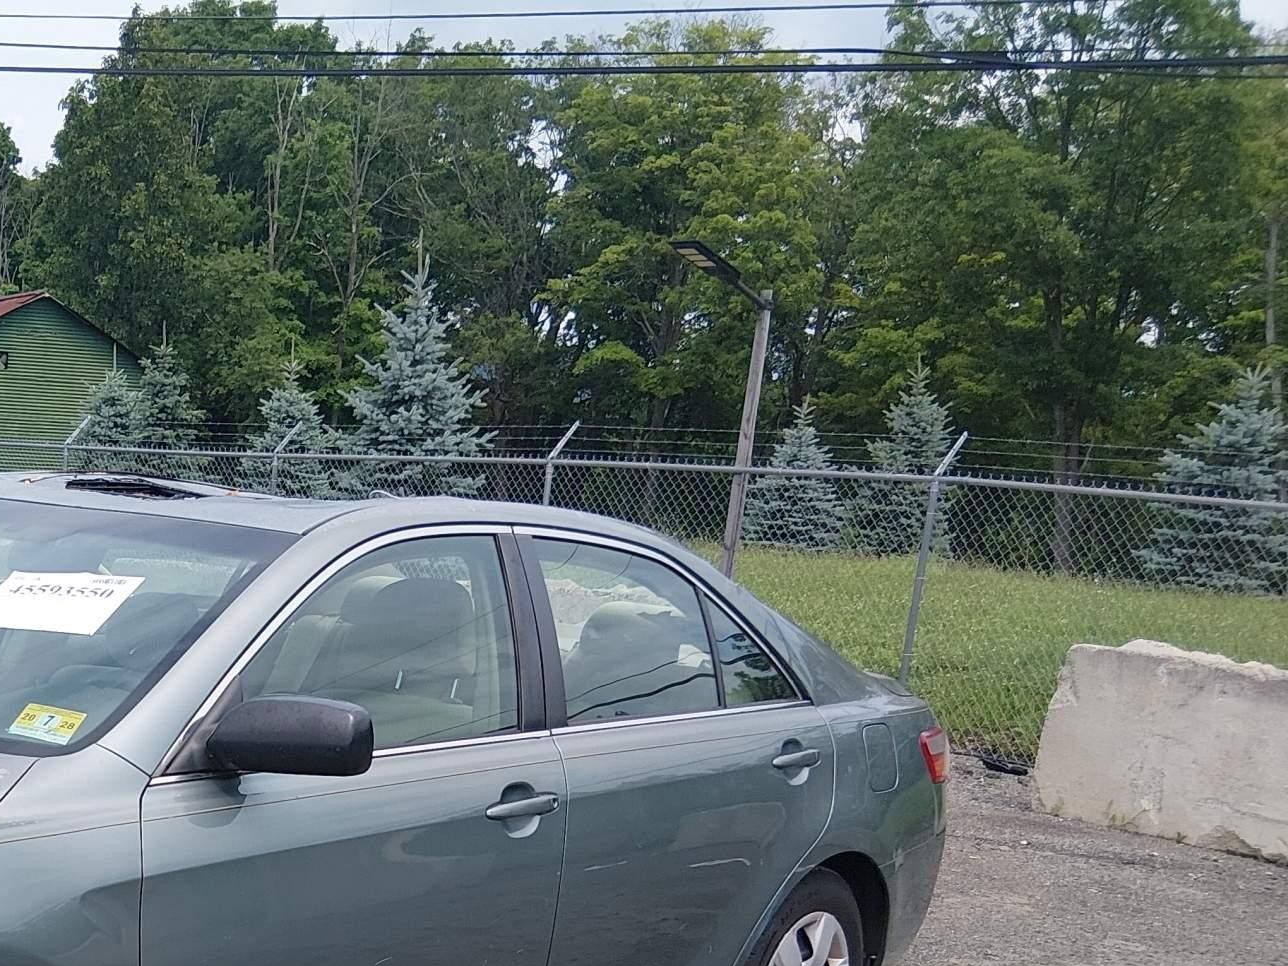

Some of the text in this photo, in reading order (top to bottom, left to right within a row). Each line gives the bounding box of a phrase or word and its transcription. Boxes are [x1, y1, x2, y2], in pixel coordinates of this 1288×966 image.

[22, 712, 37, 721] 20
[43, 715, 56, 726] 7
[59, 721, 75, 730] 28
